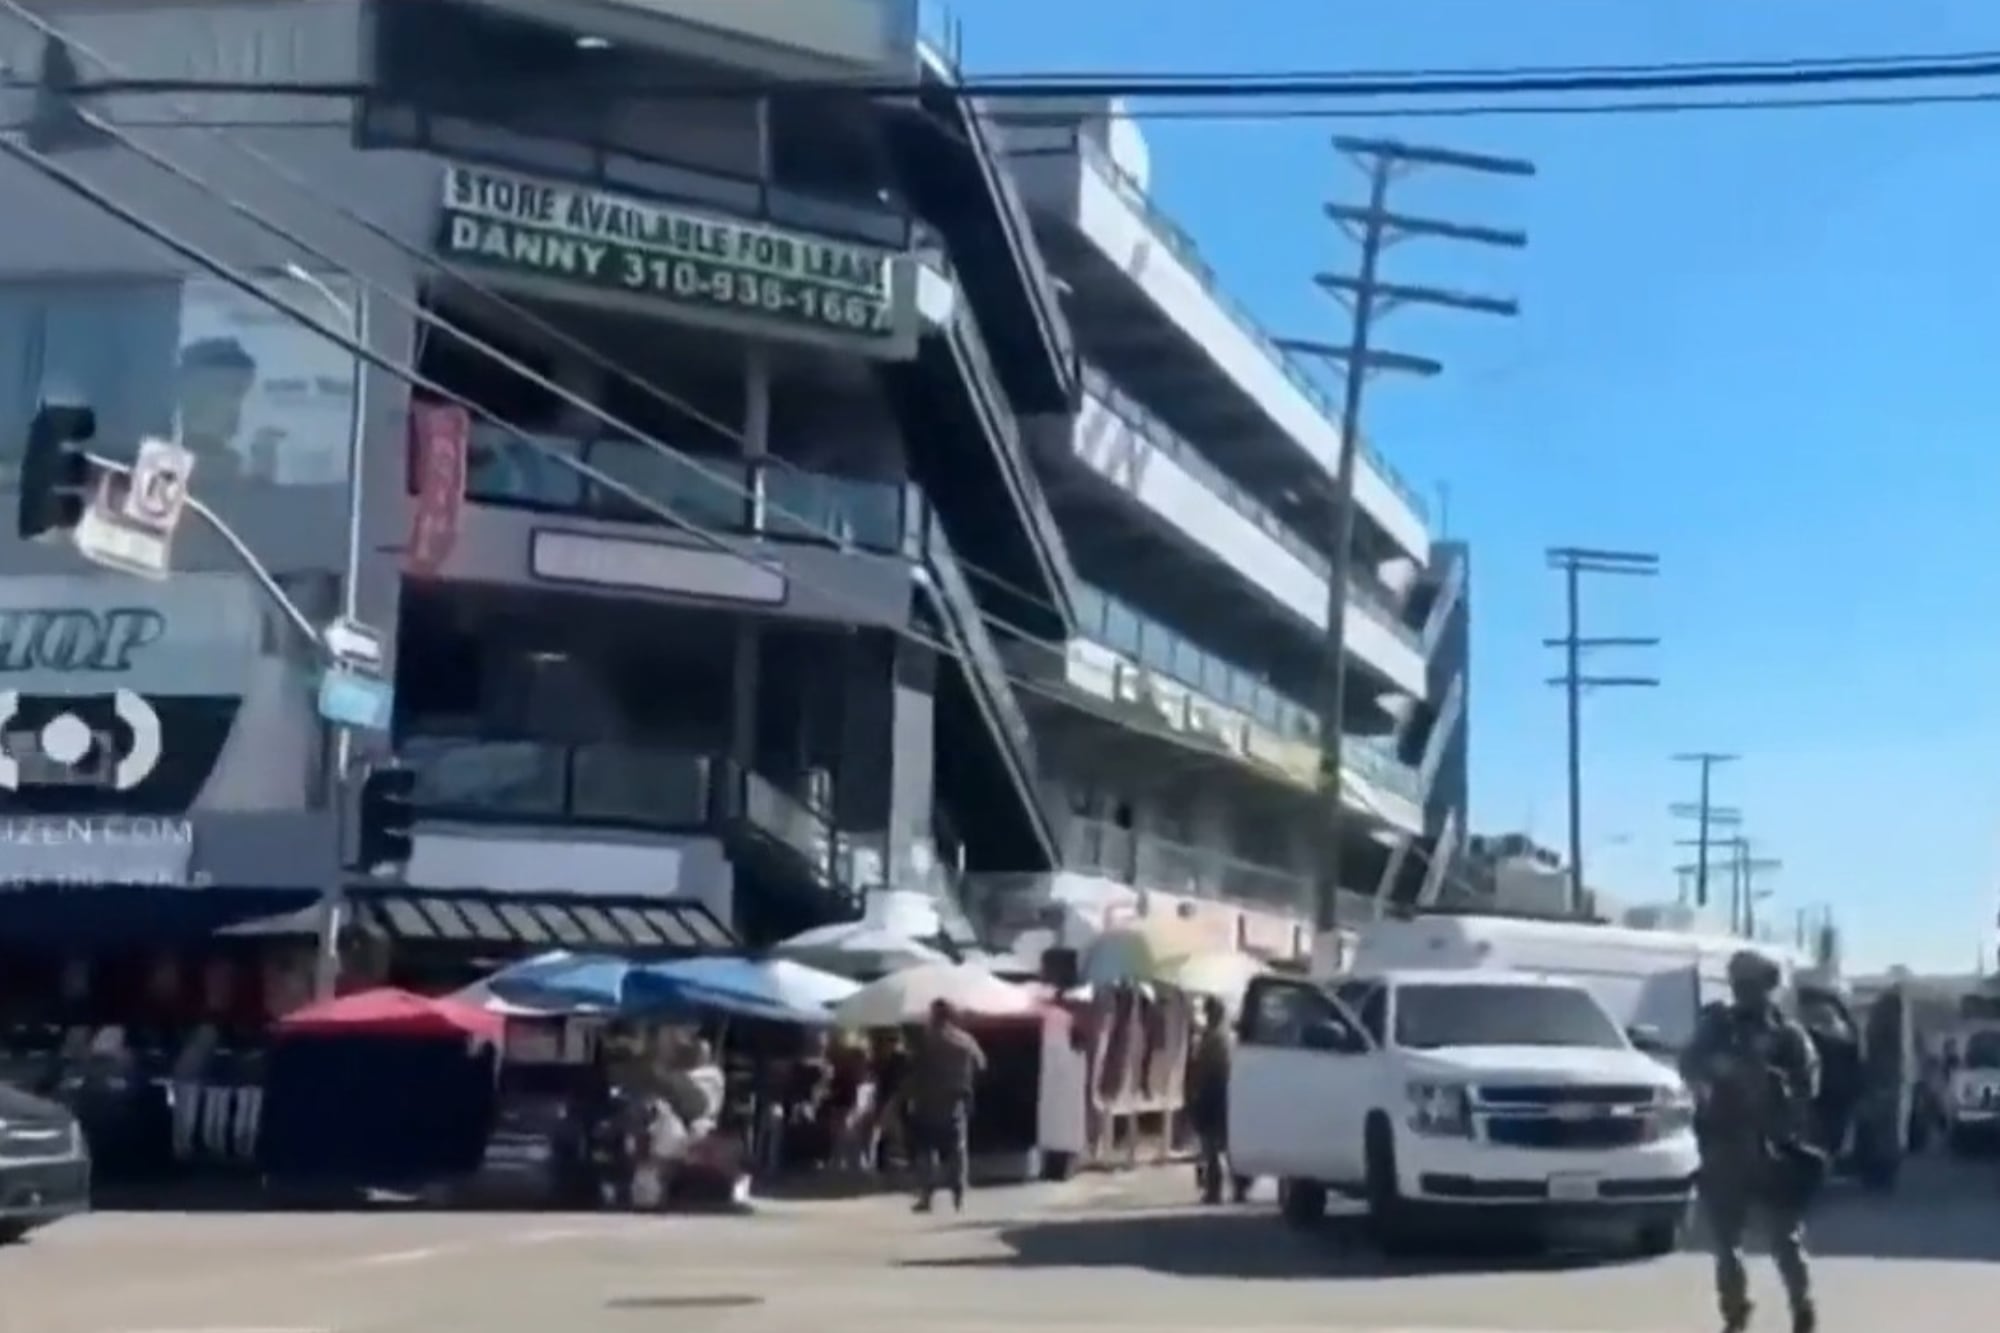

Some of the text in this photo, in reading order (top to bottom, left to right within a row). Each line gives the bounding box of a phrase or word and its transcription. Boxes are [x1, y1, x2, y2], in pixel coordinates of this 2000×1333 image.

[451, 215, 606, 276] DANNY
[454, 168, 556, 221] STORE
[566, 194, 728, 258] AVAILABLE
[738, 231, 795, 271] FOR
